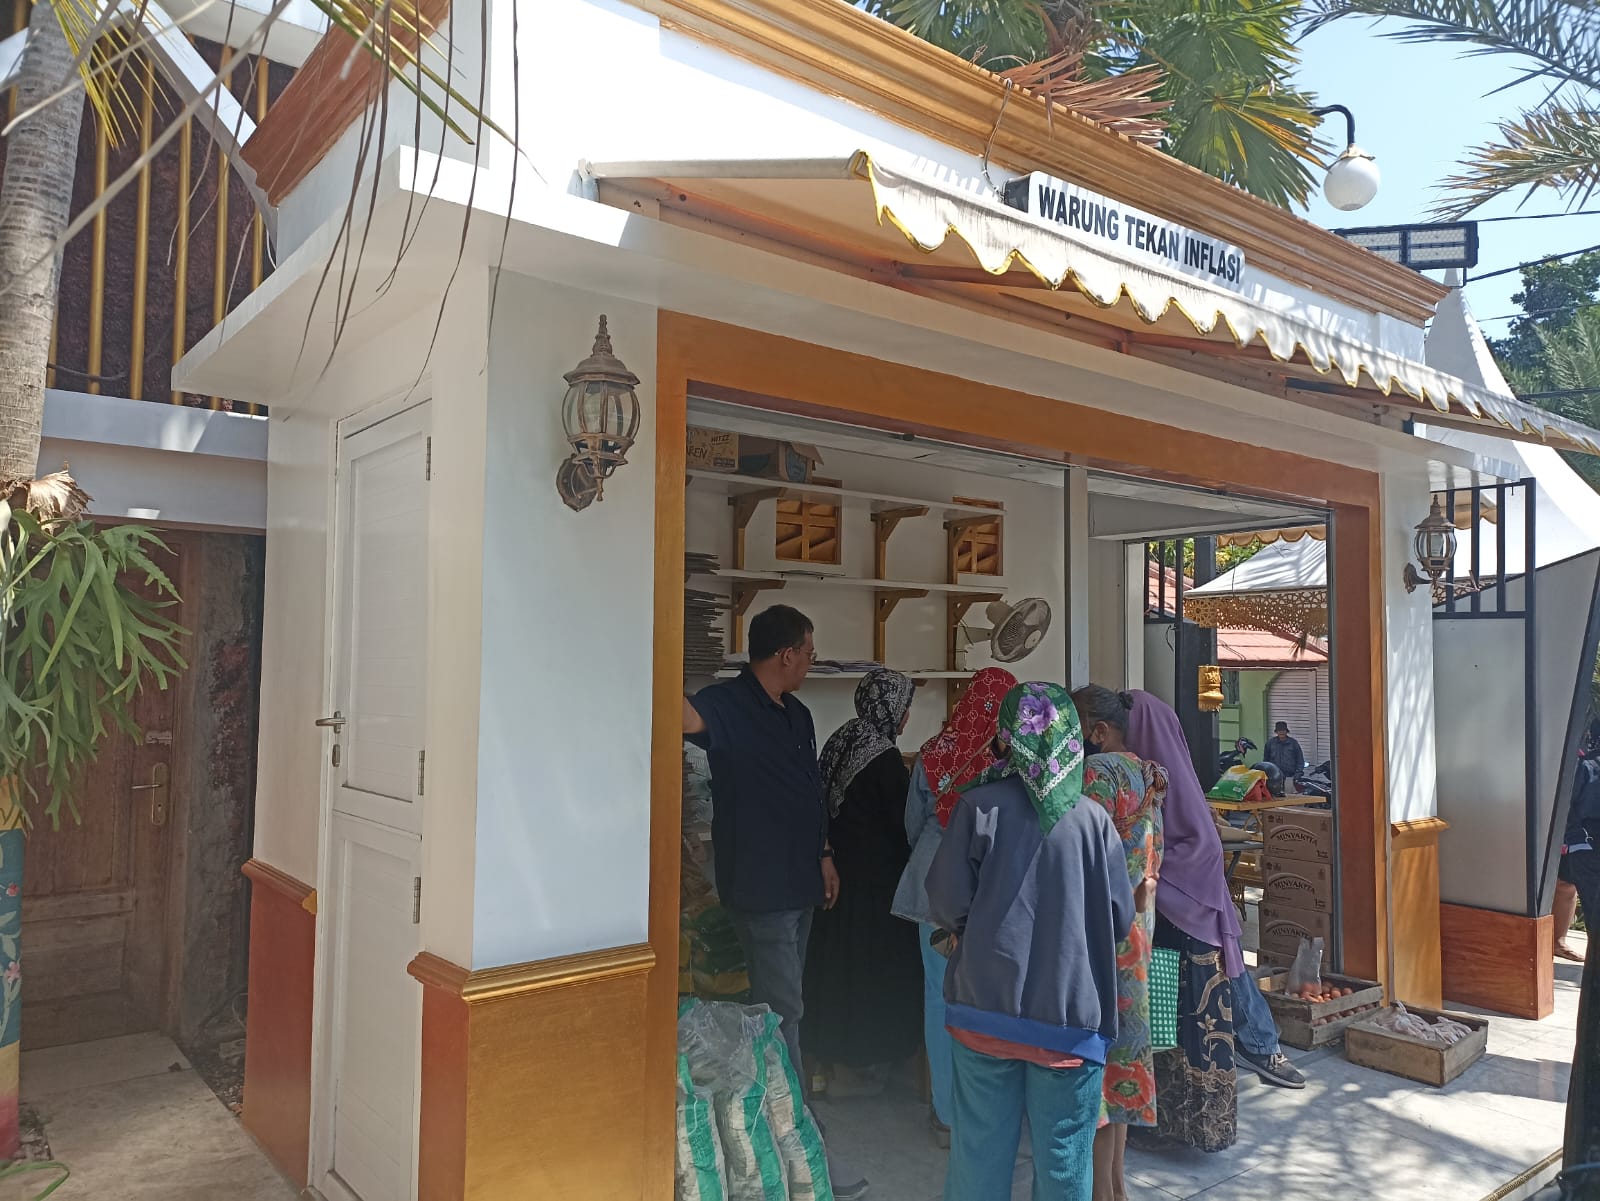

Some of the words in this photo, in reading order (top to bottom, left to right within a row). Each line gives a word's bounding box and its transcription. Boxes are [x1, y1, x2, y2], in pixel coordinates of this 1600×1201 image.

[1038, 183, 1119, 241] WARUNG
[1125, 214, 1180, 262] TEKAN
[1184, 235, 1241, 284] INFLASI
